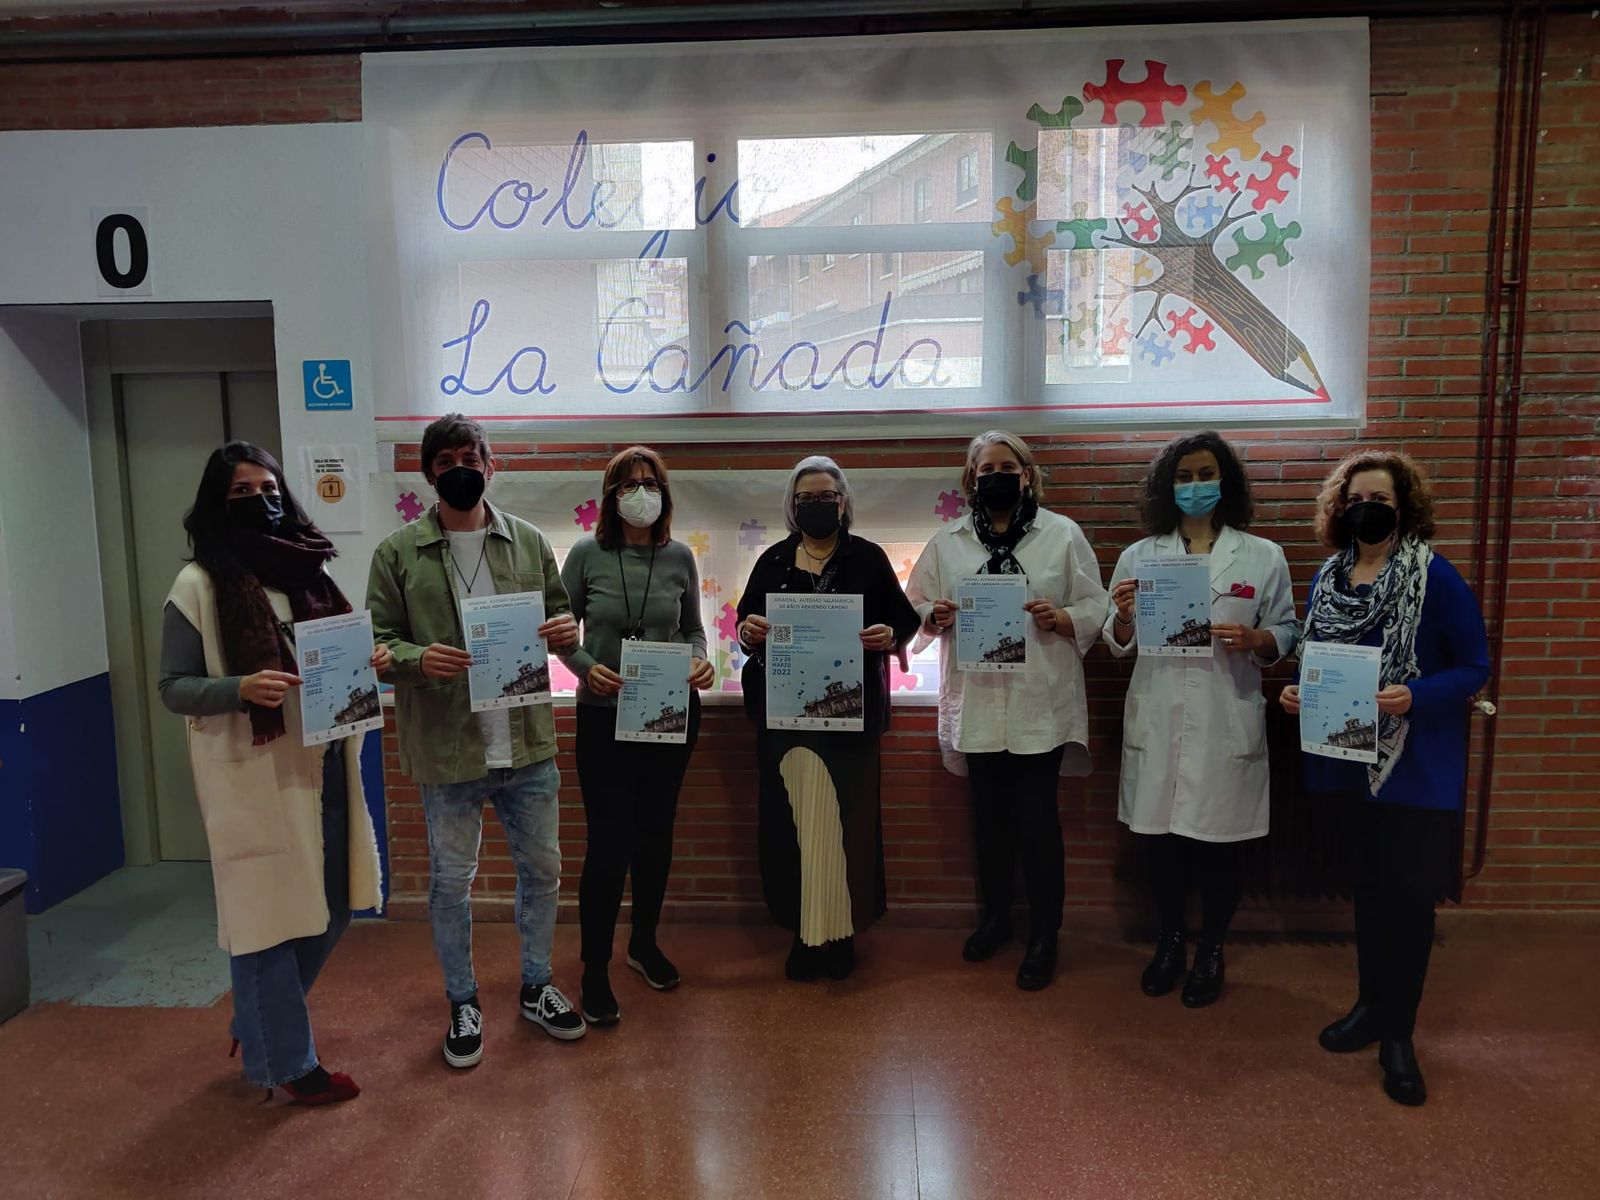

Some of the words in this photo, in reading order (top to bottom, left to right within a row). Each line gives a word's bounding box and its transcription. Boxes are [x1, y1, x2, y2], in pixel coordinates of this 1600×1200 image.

[96, 213, 148, 288] 0
[441, 299, 556, 396] La
[597, 291, 950, 393] Cañada
